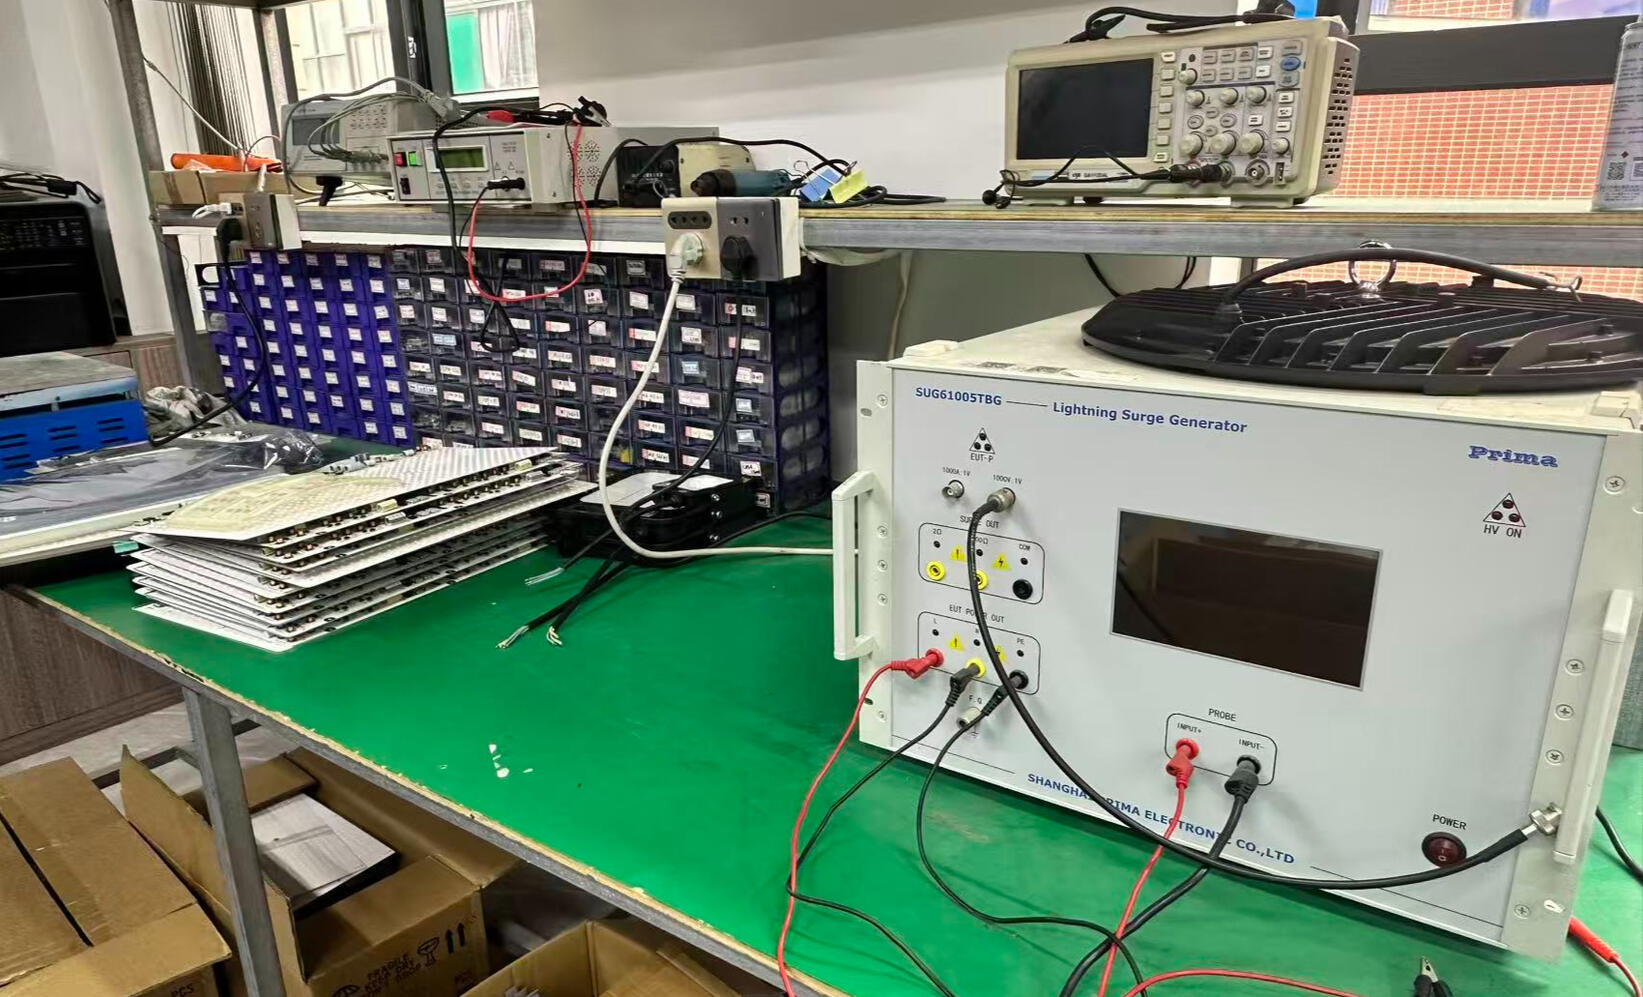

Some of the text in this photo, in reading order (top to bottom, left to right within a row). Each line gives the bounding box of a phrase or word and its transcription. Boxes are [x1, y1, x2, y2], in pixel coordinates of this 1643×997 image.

[915, 387, 1002, 406] SUG61005TBG
[1052, 402, 1248, 433] Lightning Surge Generator
[970, 453, 994, 463] EUT-P
[1468, 445, 1559, 468] Prima
[985, 520, 1000, 529] OUT
[1483, 524, 1523, 539] HV ON
[949, 604, 963, 613] EUT
[991, 614, 1005, 623] OUT
[1208, 708, 1237, 722] PROBE
[1177, 722, 1202, 734] INPUT+
[1238, 738, 1265, 751] INPUT-
[1027, 773, 1093, 801] SHANGHA
[1236, 839, 1295, 865] CO.,LTD
[1433, 814, 1467, 830] POWER
